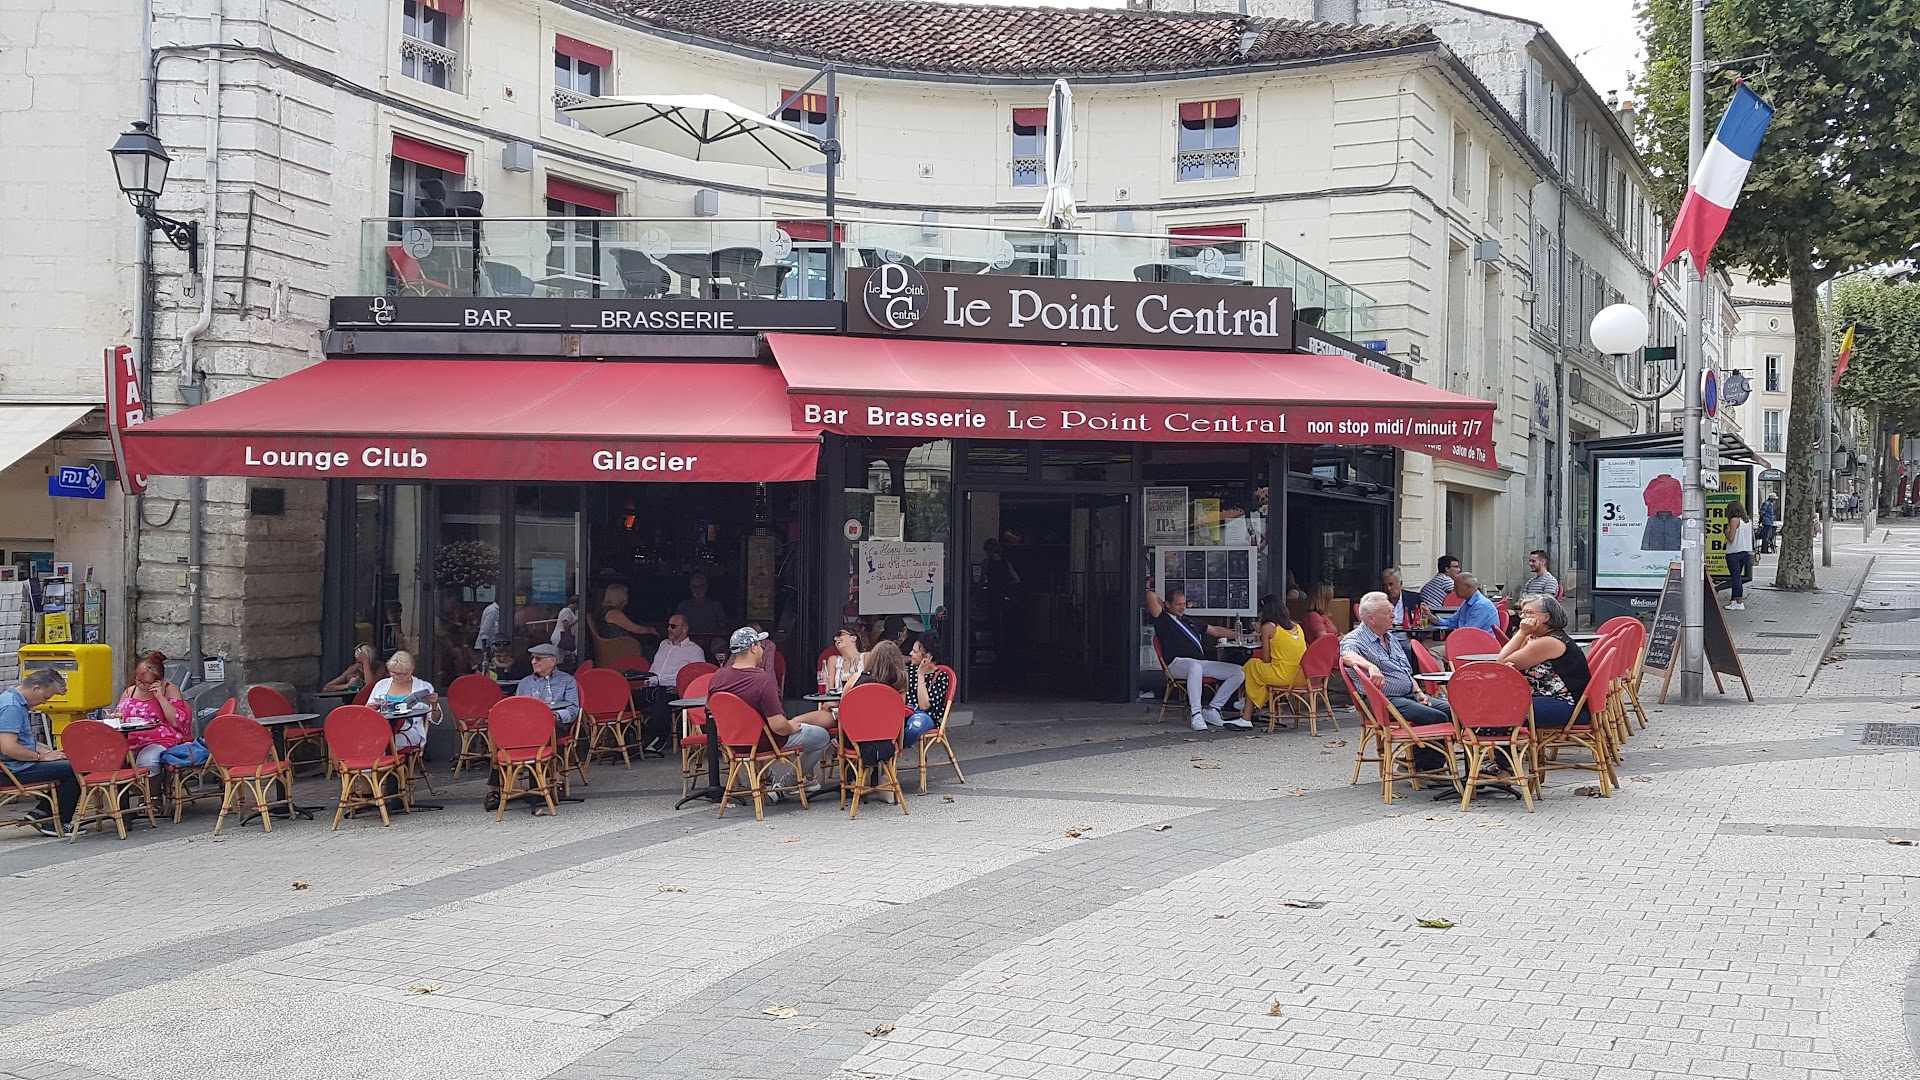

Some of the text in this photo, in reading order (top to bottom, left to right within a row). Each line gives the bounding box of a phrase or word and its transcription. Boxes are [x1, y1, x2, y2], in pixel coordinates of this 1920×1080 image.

[868, 264, 924, 298] Le Point
[464, 310, 512, 327] BAR
[600, 310, 734, 329] BRASSERIE
[886, 296, 920, 329] Central
[944, 286, 1279, 338] Le Point Central
[804, 404, 848, 424] Bar
[867, 406, 986, 428] Brasserie
[1007, 410, 1046, 430] Le
[1060, 410, 1152, 431] Point
[1164, 413, 1287, 432] Central
[1307, 420, 1333, 434] non
[1338, 418, 1369, 437] stop
[1462, 420, 1482, 438] 7/7
[244, 446, 428, 470] Lounge Club
[592, 450, 698, 472] Glacier
[1476, 448, 1486, 462] Thé
[62, 470, 82, 484] FDJ
[1156, 519, 1176, 532] IPA
[880, 542, 917, 559] Happy hour
